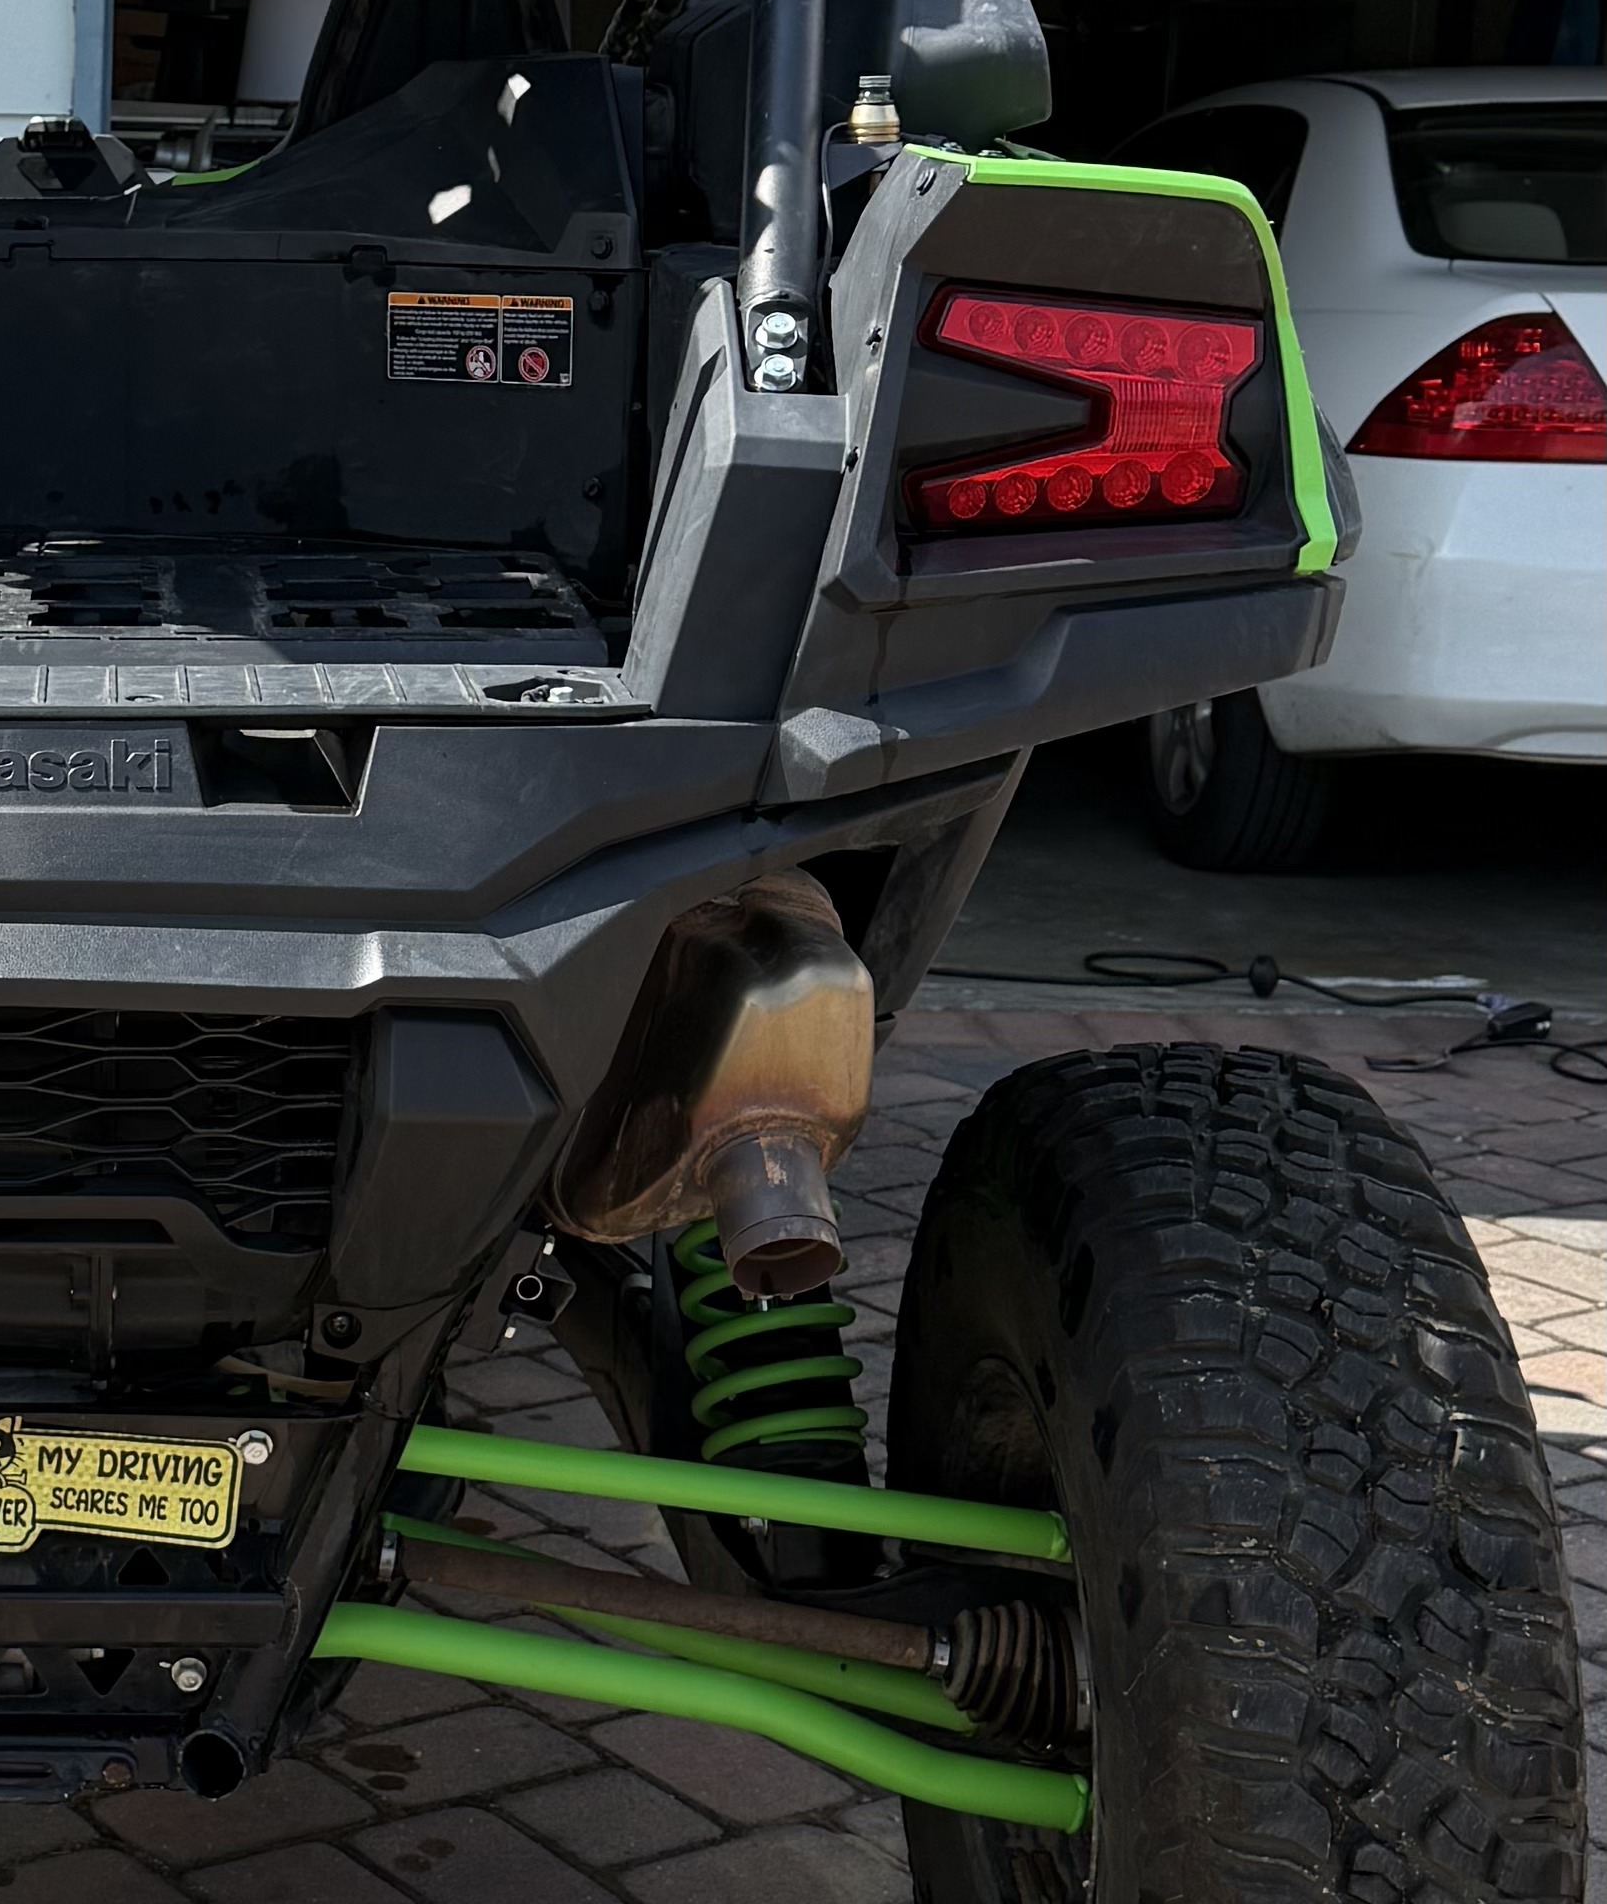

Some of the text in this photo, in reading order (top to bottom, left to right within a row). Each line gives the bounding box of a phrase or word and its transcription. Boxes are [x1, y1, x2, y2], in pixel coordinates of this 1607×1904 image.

[427, 296, 471, 306] WARNING
[520, 299, 564, 309] WARNING
[37, 1446, 223, 1487] MY DRIVING
[50, 1488, 220, 1526] SCARES ME TOO
